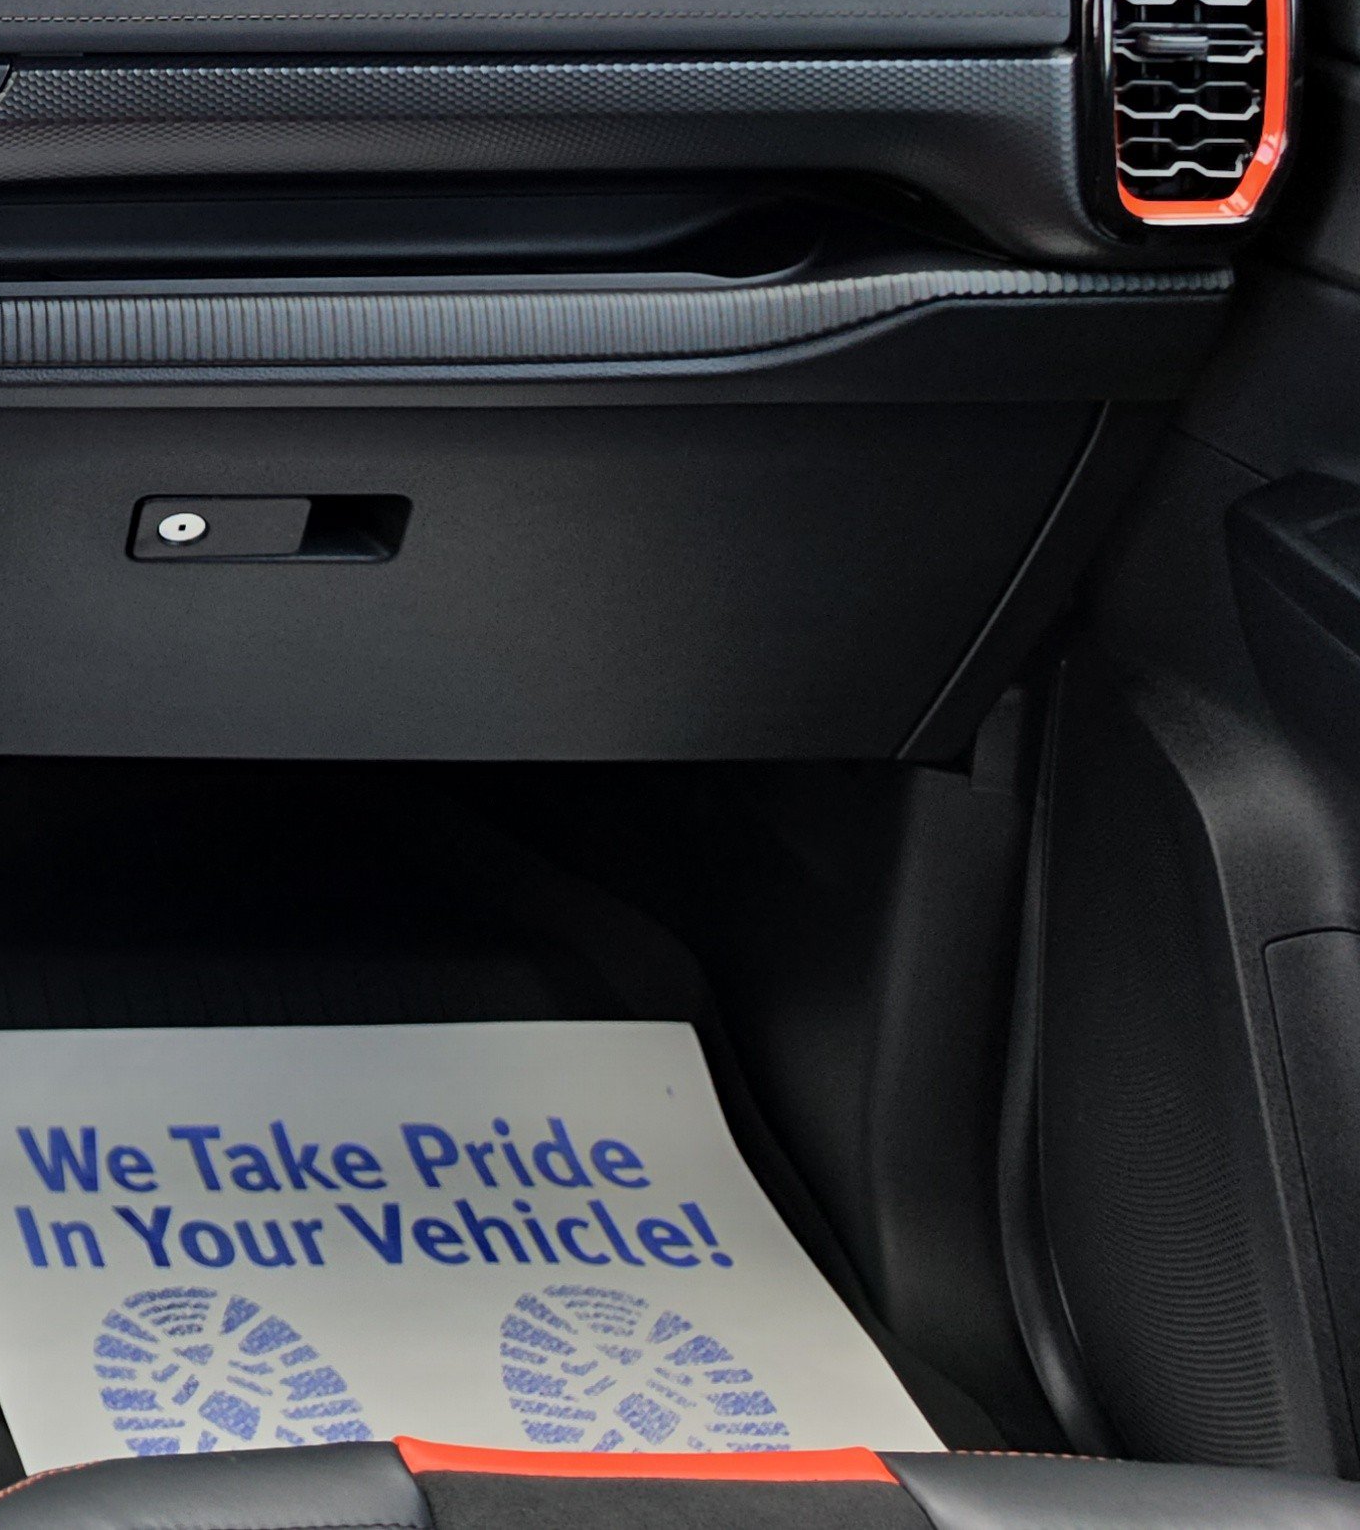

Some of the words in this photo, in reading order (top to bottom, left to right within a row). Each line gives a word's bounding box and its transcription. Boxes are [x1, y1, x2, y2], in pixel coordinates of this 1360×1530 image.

[15, 1125, 156, 1194] We
[168, 1118, 388, 1193] Take
[399, 1116, 652, 1192] Pride
[14, 1205, 106, 1270] In
[114, 1204, 326, 1270] Your
[335, 1199, 735, 1269] Vehicle!
